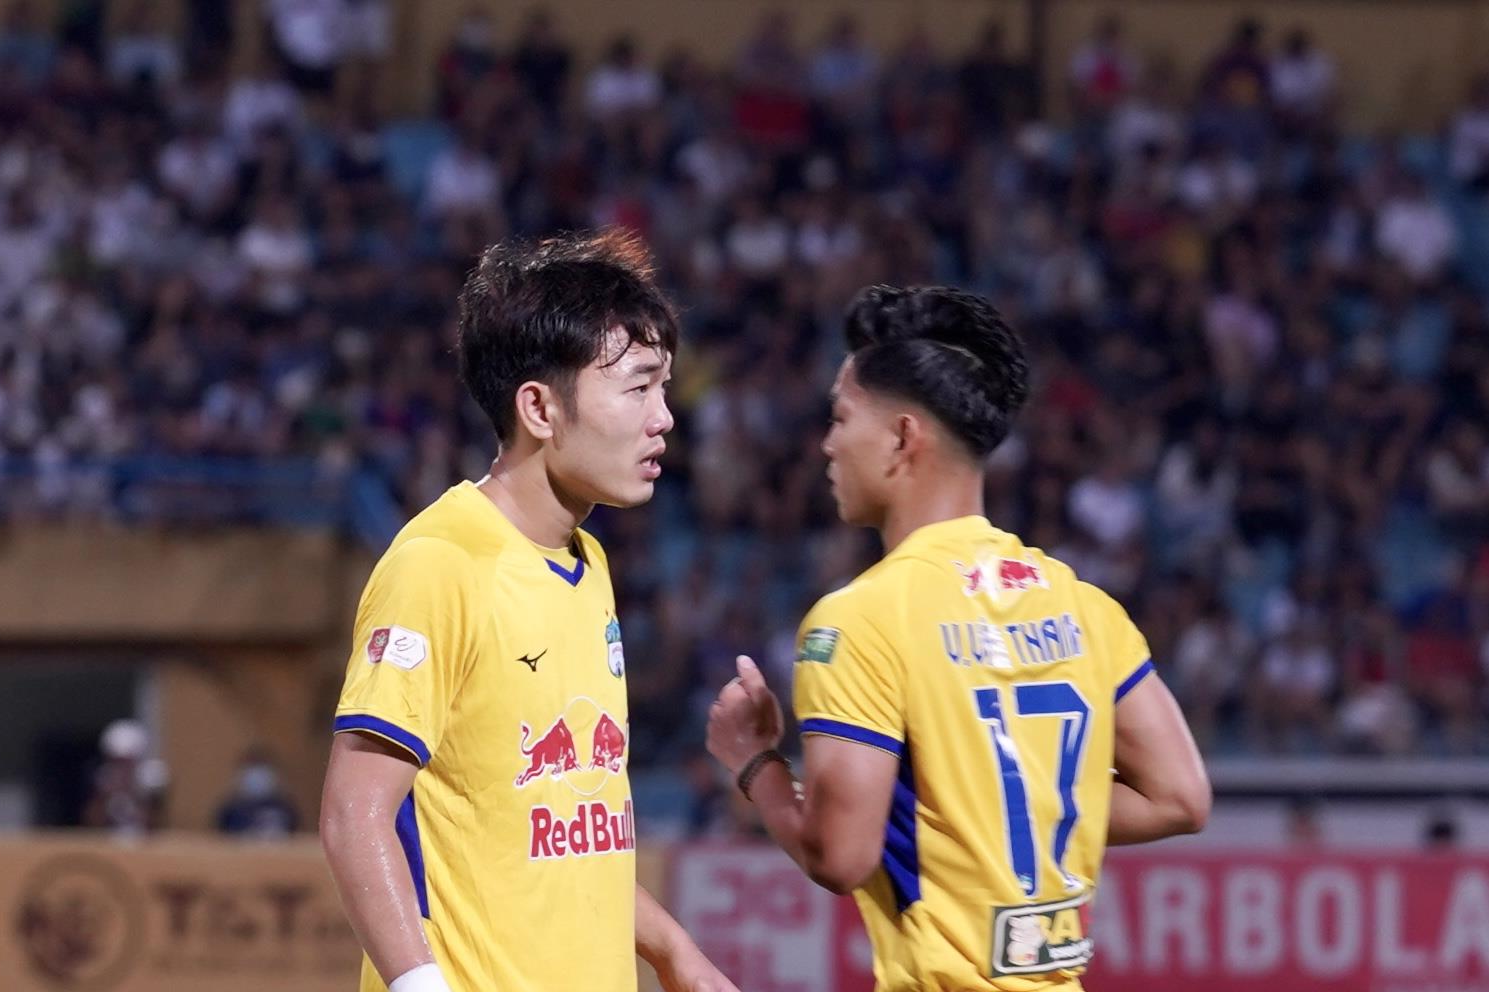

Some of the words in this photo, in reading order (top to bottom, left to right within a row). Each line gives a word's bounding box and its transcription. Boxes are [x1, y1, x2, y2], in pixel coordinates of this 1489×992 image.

[530, 804, 589, 858] Red
[590, 800, 634, 852] Bull
[971, 682, 1092, 899] 17
